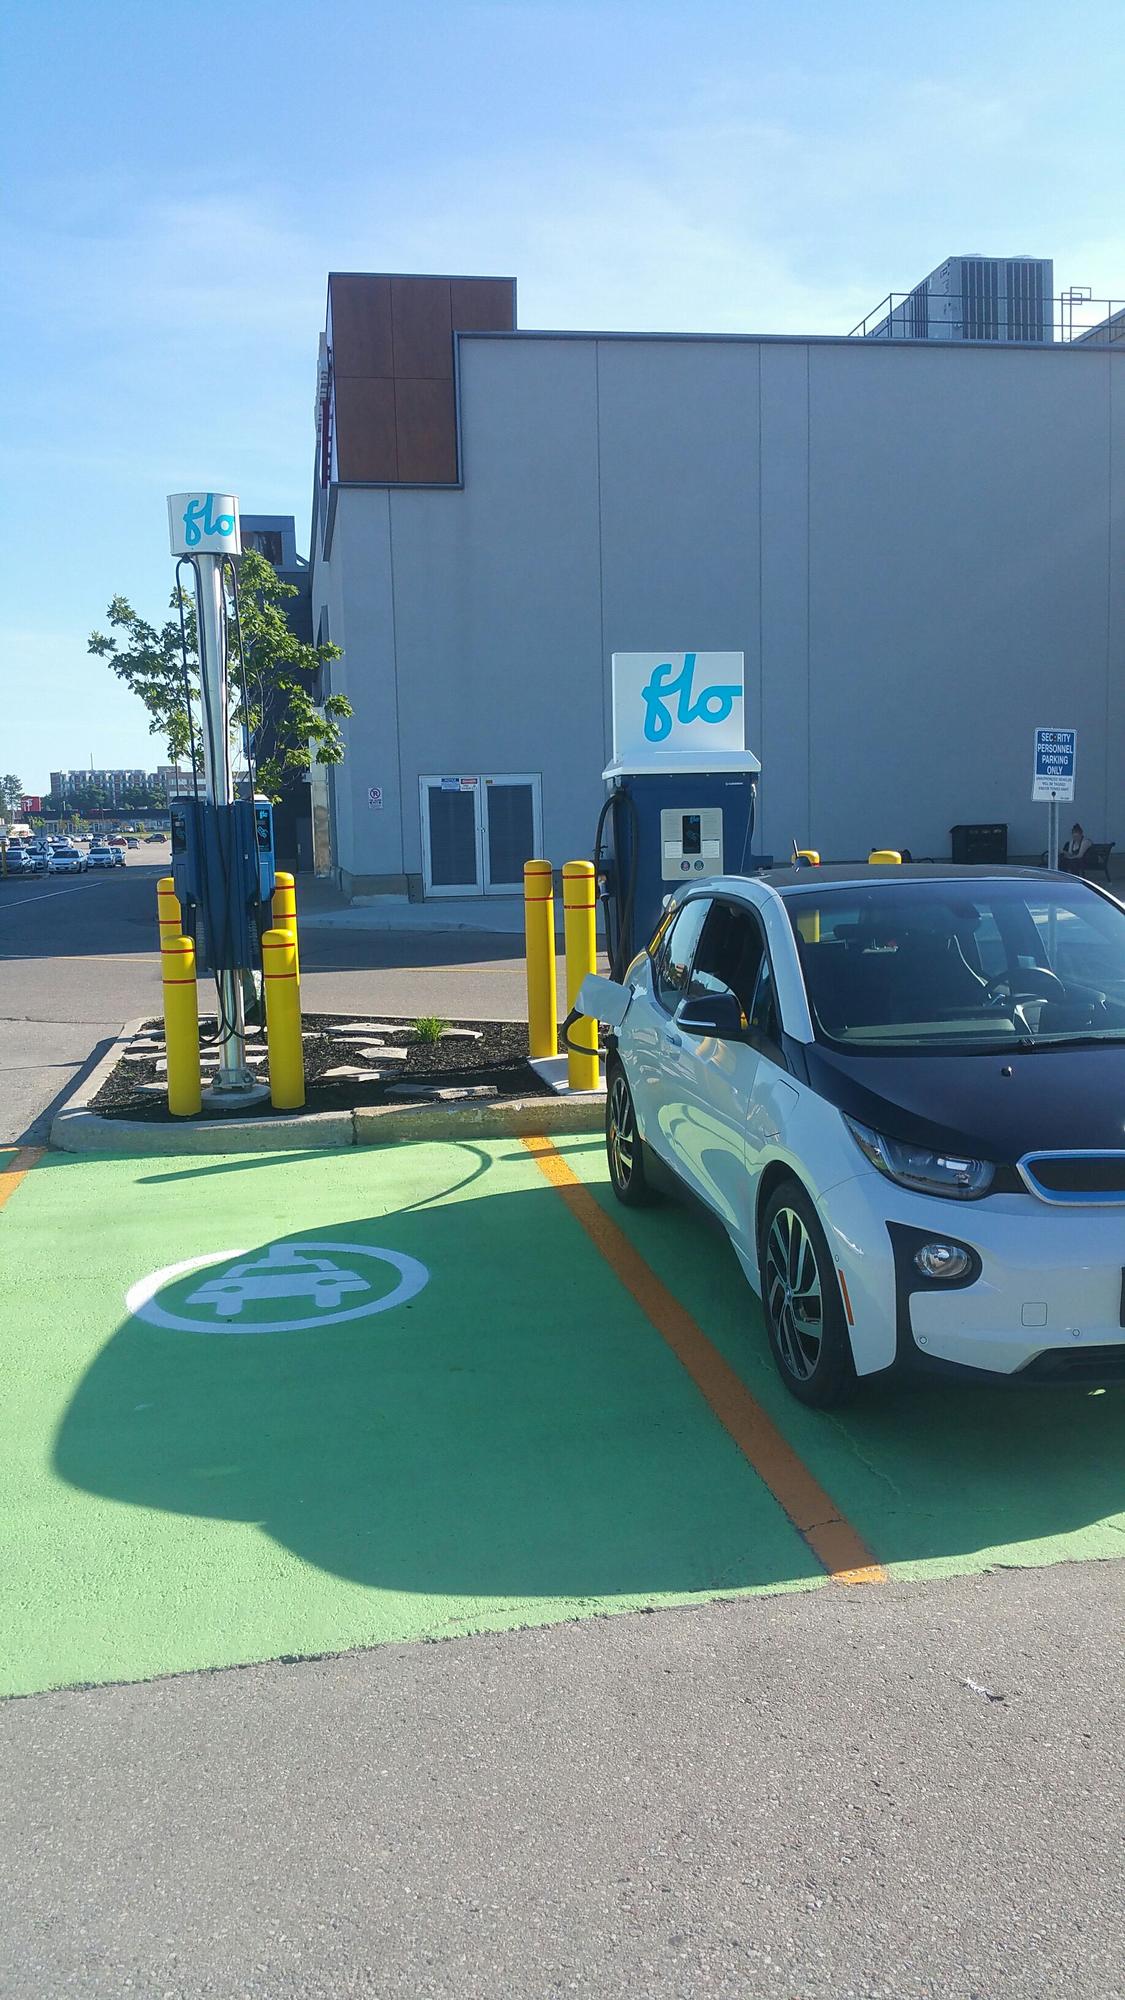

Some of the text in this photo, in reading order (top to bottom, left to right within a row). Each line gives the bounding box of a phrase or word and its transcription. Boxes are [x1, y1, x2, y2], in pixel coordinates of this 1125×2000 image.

[183, 493, 235, 546] flo
[641, 653, 743, 742] flo
[1041, 733, 1071, 742] SECRITY
[1037, 744, 1073, 753] PERSONNEL
[1042, 755, 1068, 765] PARKING
[1047, 766, 1063, 775] ONLY
